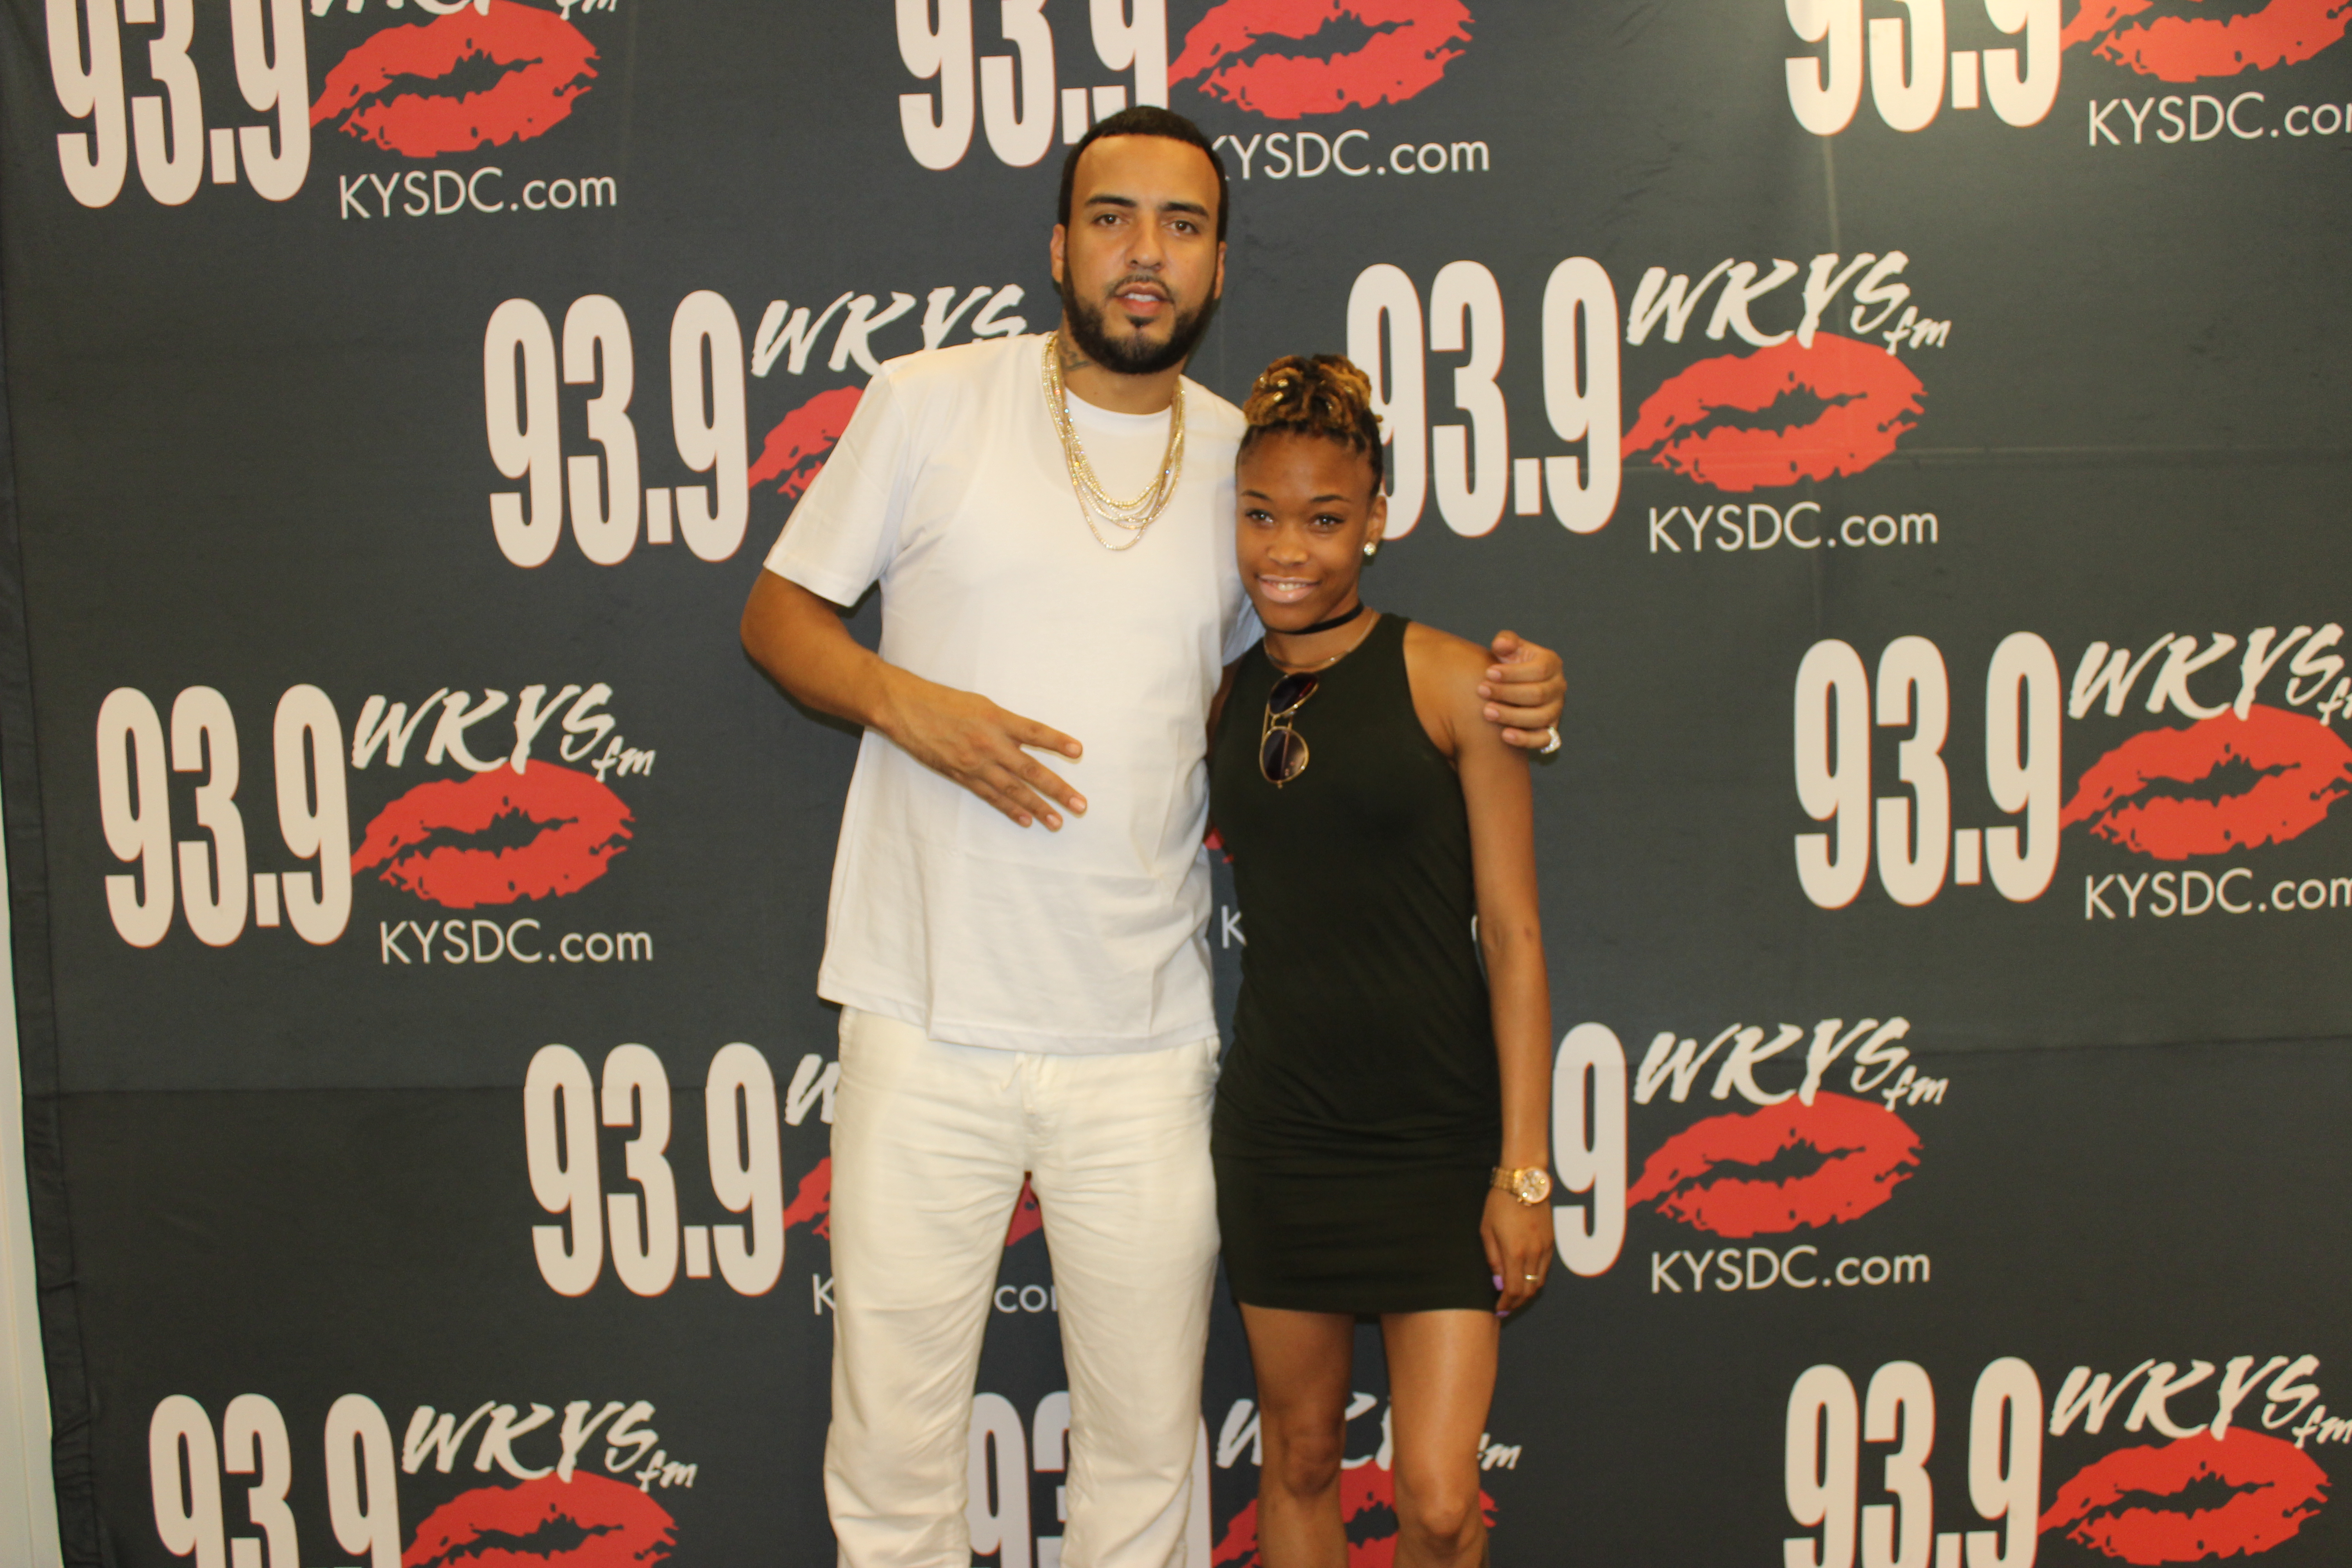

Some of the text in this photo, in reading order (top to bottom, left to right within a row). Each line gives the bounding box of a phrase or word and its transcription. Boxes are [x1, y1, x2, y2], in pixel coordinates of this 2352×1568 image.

[44, 0, 312, 208] 93.9
[339, 166, 617, 220] KYSDC.com
[2087, 90, 2352, 148] KYSDC.co
[483, 289, 750, 568] 93.9
[1345, 255, 1622, 540] 93.9
[1648, 500, 1939, 554] KYSDC.com
[96, 683, 353, 947] 93.9
[1793, 631, 2061, 909] 93.9
[380, 917, 653, 965] KYSDC.com
[2084, 867, 2352, 920] KYSDC.com
[523, 1041, 785, 1296] 93.9
[1651, 1244, 1930, 1294] KYSDC.com
[149, 1392, 402, 1568] 93.9
[1783, 1356, 2043, 1568] 93.9
